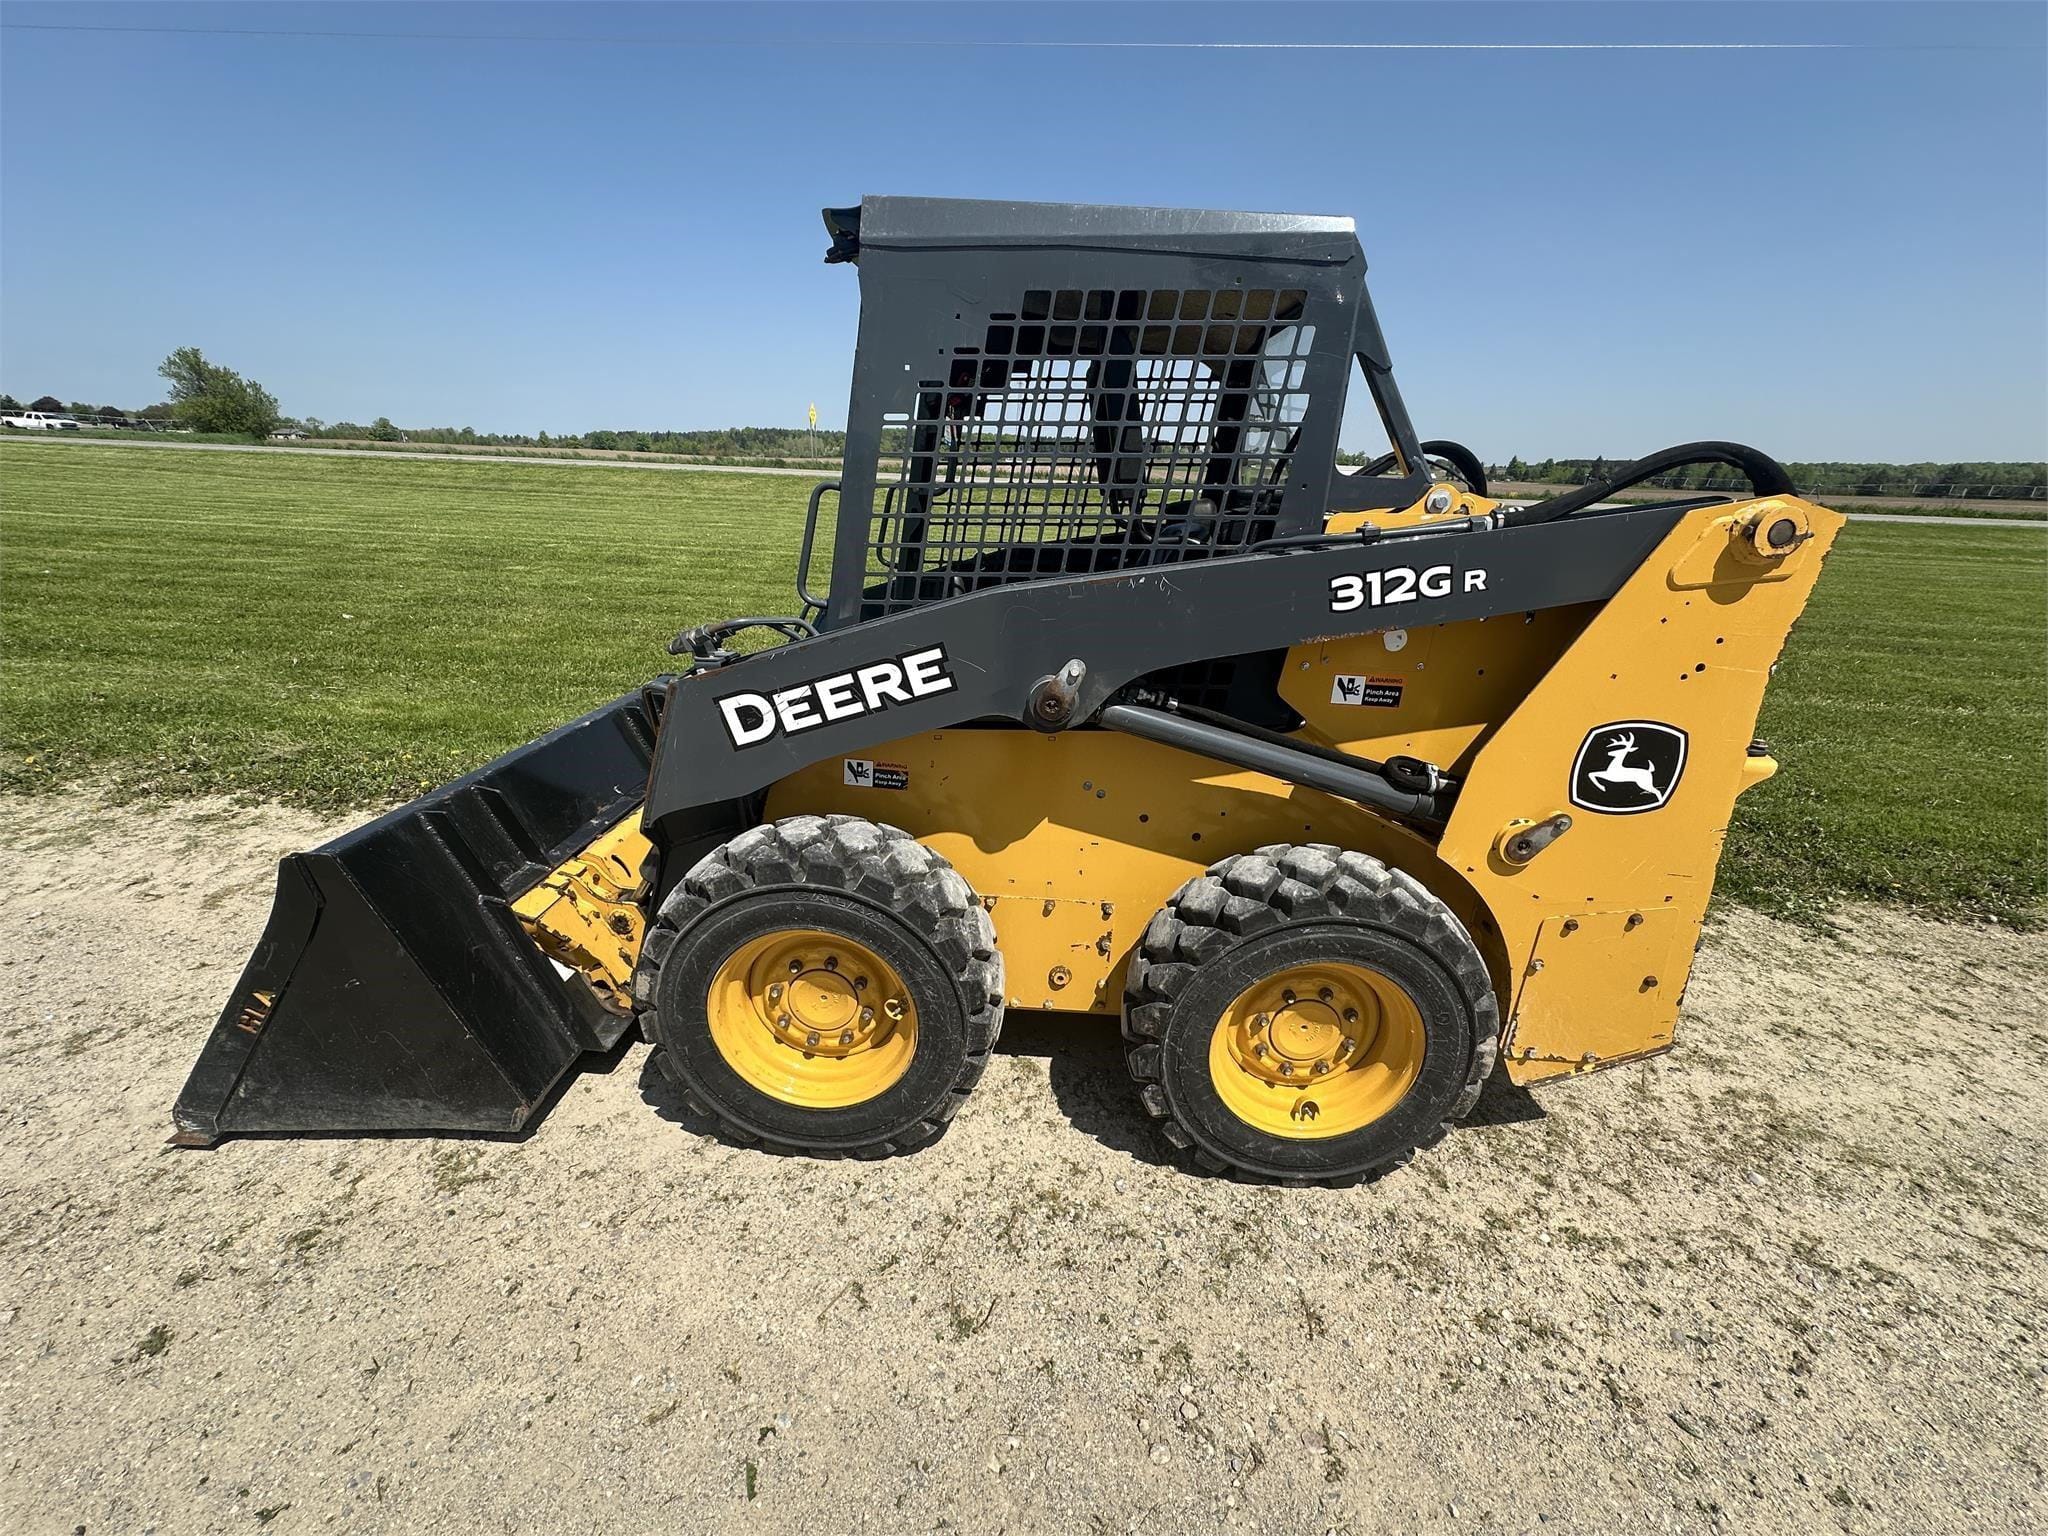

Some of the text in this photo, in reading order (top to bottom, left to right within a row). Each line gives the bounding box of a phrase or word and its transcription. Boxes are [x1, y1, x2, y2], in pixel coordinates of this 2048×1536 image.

[1330, 565, 1488, 612] 312G R
[717, 647, 953, 747] DEERE
[235, 991, 276, 1035] HLA
